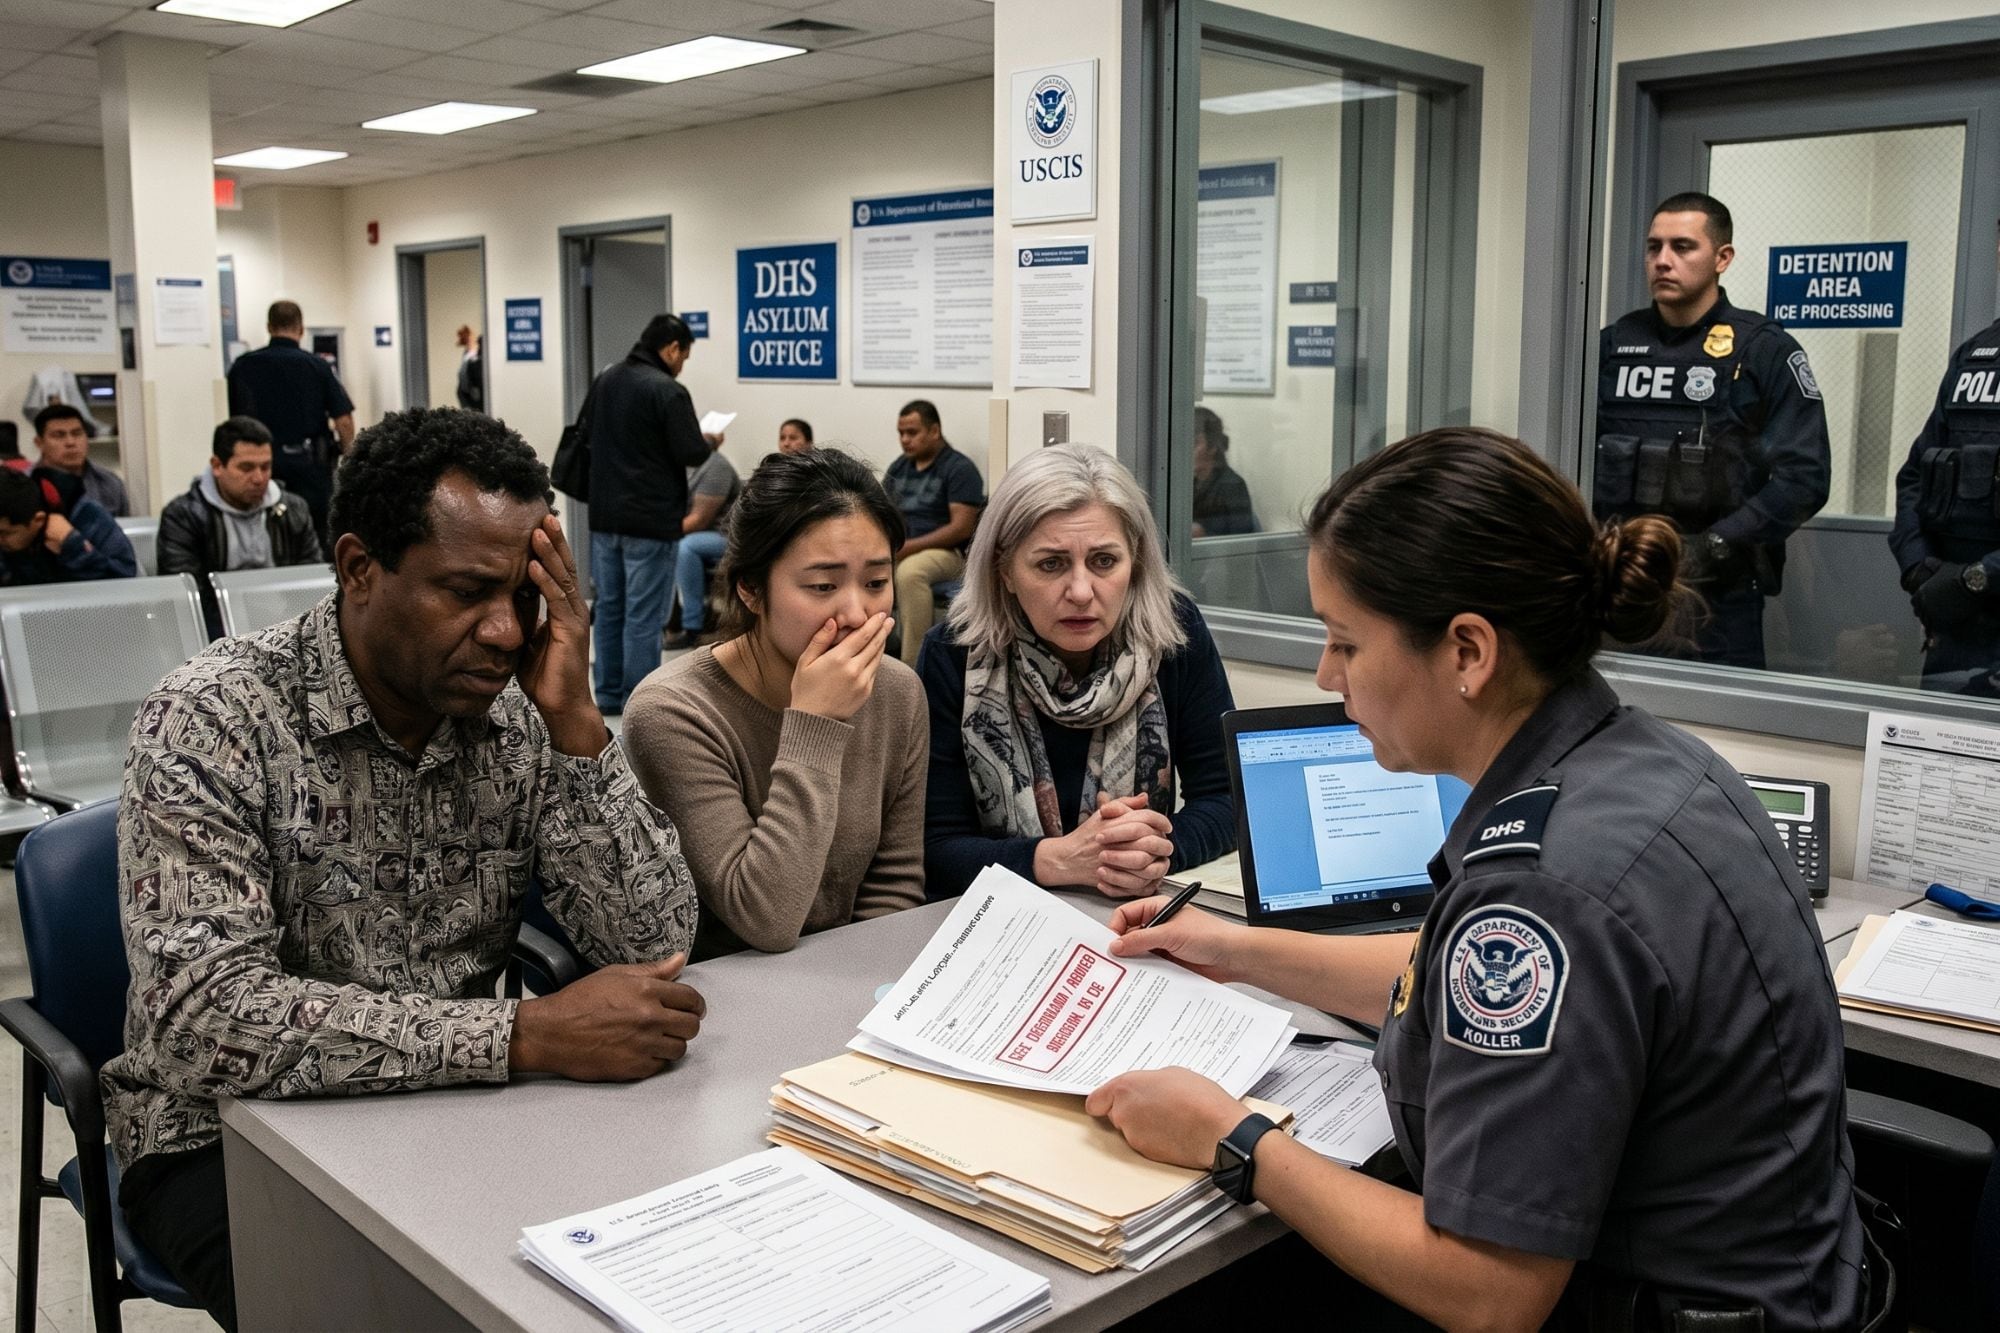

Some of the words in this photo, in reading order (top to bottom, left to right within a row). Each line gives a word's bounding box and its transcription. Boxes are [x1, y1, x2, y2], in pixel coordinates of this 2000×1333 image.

[1020, 154, 1083, 182] USCIS
[1778, 251, 1894, 275] DETENTION
[754, 257, 817, 298] DHS
[1806, 277, 1862, 298] AREA
[743, 306, 829, 333] ASYLUM
[1774, 305, 1798, 319] ICE
[1801, 303, 1894, 319] PROCESSING
[749, 339, 823, 367] OFFICE
[1615, 365, 1676, 399] ICE
[1480, 819, 1526, 841] DHS
[1537, 954, 1551, 971] OF
[1463, 1027, 1521, 1048] KOLLER
